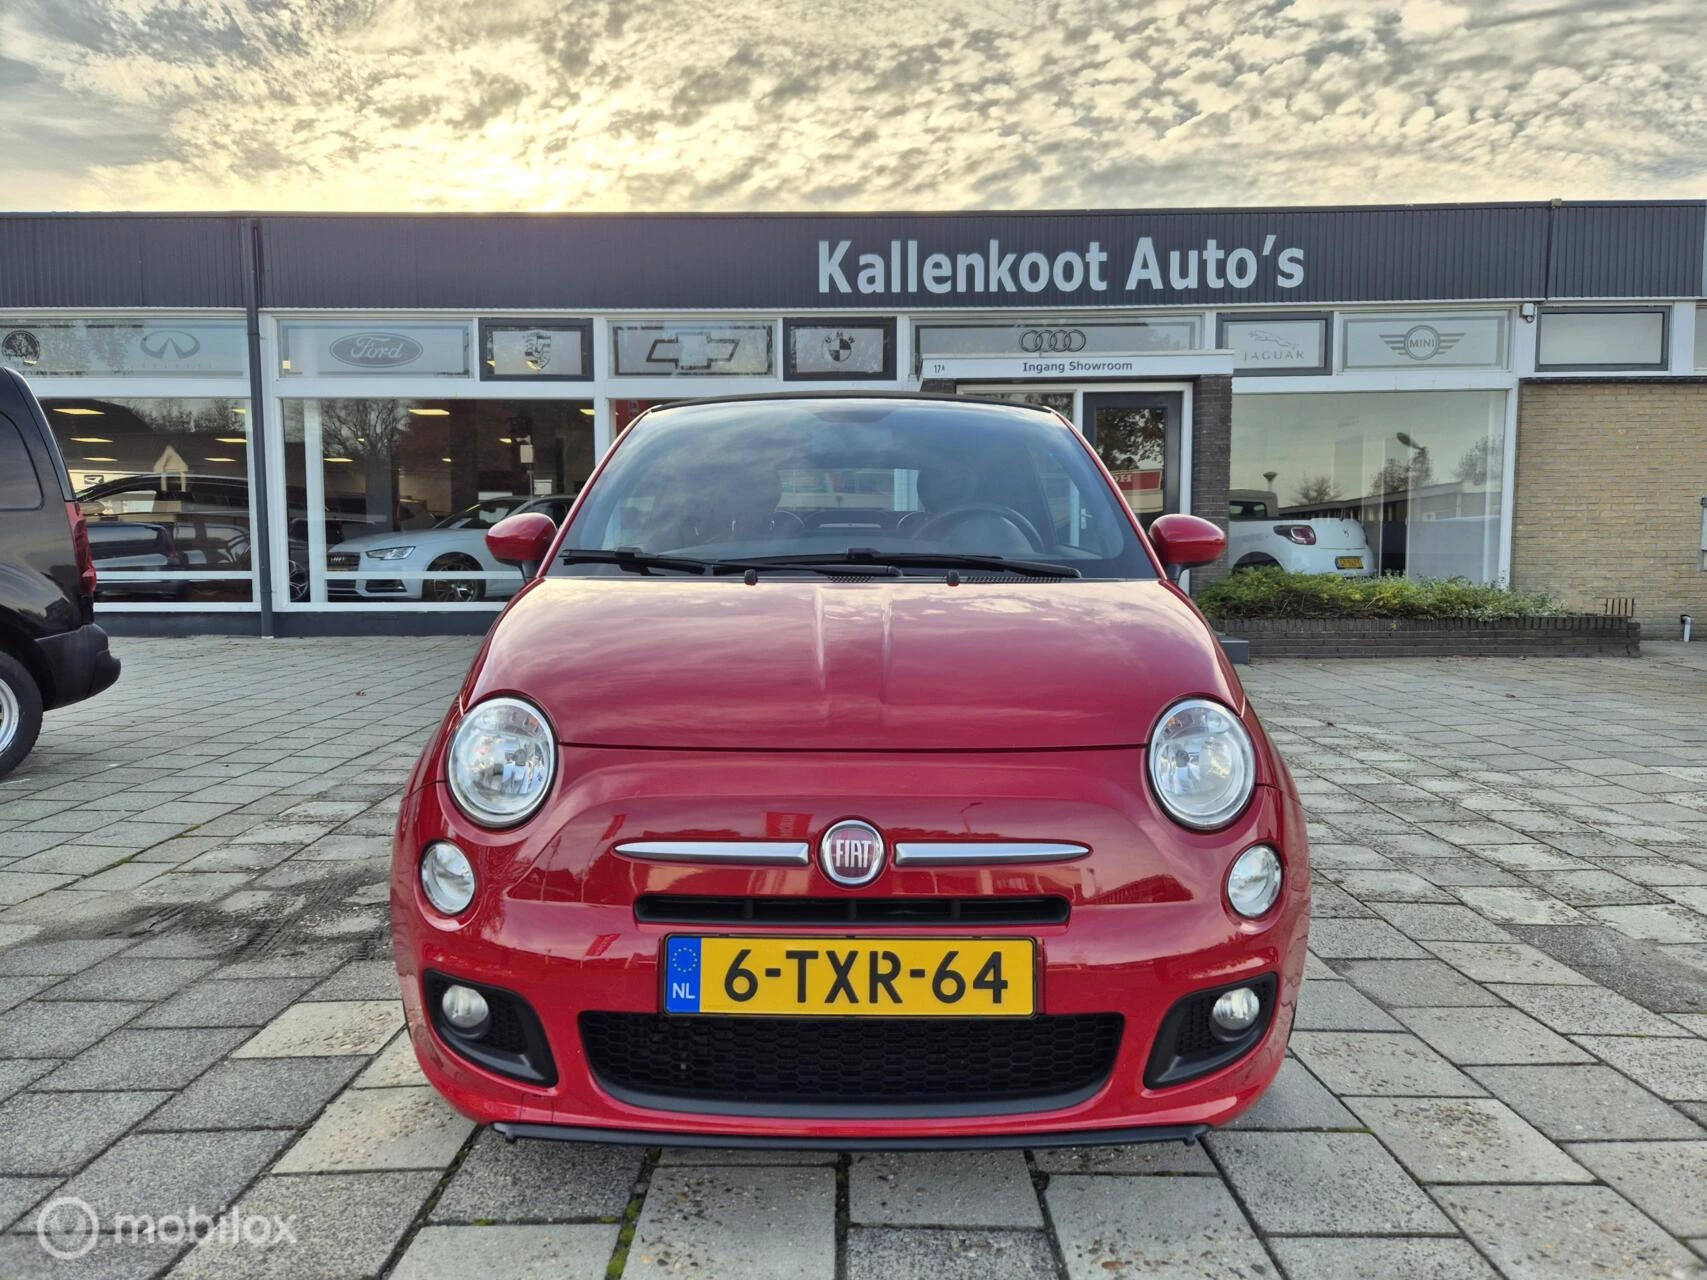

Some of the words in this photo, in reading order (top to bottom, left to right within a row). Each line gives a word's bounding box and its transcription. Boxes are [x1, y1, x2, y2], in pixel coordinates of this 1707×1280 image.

[818, 239, 1107, 294] Kallenkoot
[1125, 235, 1305, 290] Auto's
[351, 337, 404, 358] Ford
[1409, 338, 1435, 348] MINI
[1243, 350, 1304, 362] JAGUAR
[1023, 362, 1065, 373] Ingang
[1069, 361, 1133, 371] Showroom
[836, 839, 872, 868] FIAT
[724, 949, 1008, 1004] 6-TXR-64
[672, 982, 696, 999] NL
